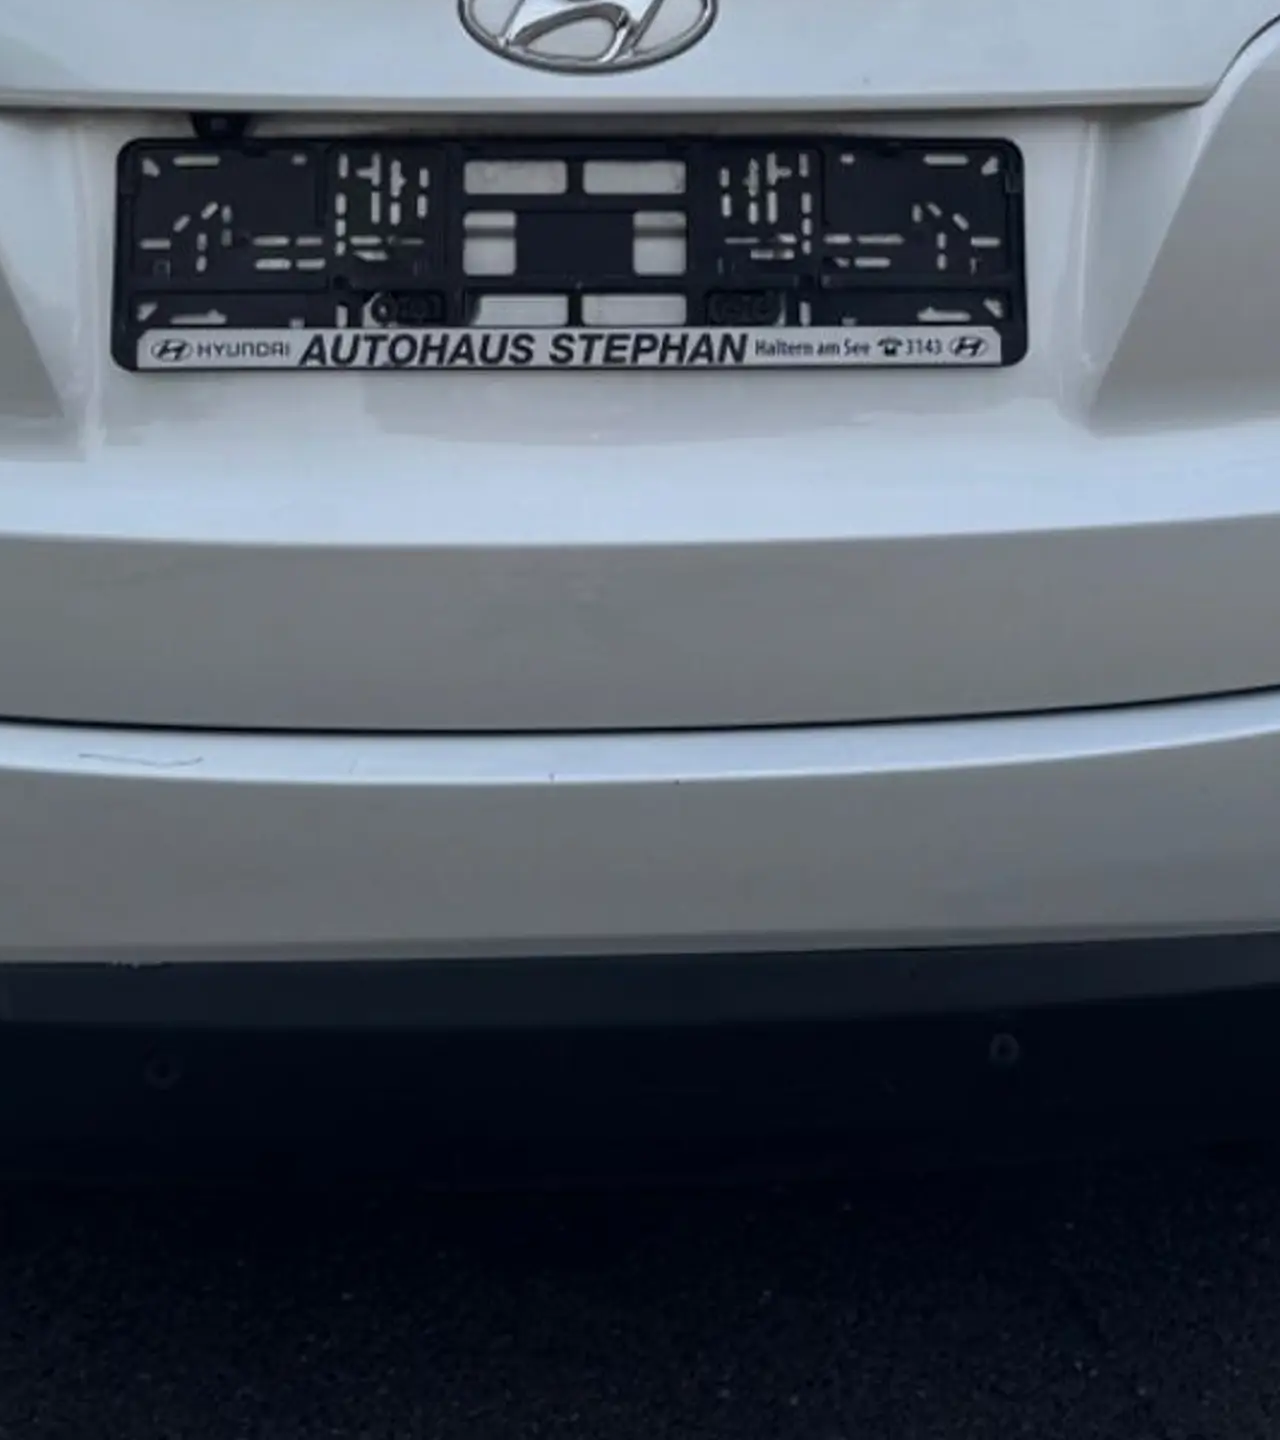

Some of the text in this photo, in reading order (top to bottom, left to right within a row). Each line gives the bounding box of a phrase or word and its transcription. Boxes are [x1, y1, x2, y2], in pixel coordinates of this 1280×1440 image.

[196, 332, 943, 367] HYUNDAI AUTOHAUS STEPHAN Haltern am See 3143
